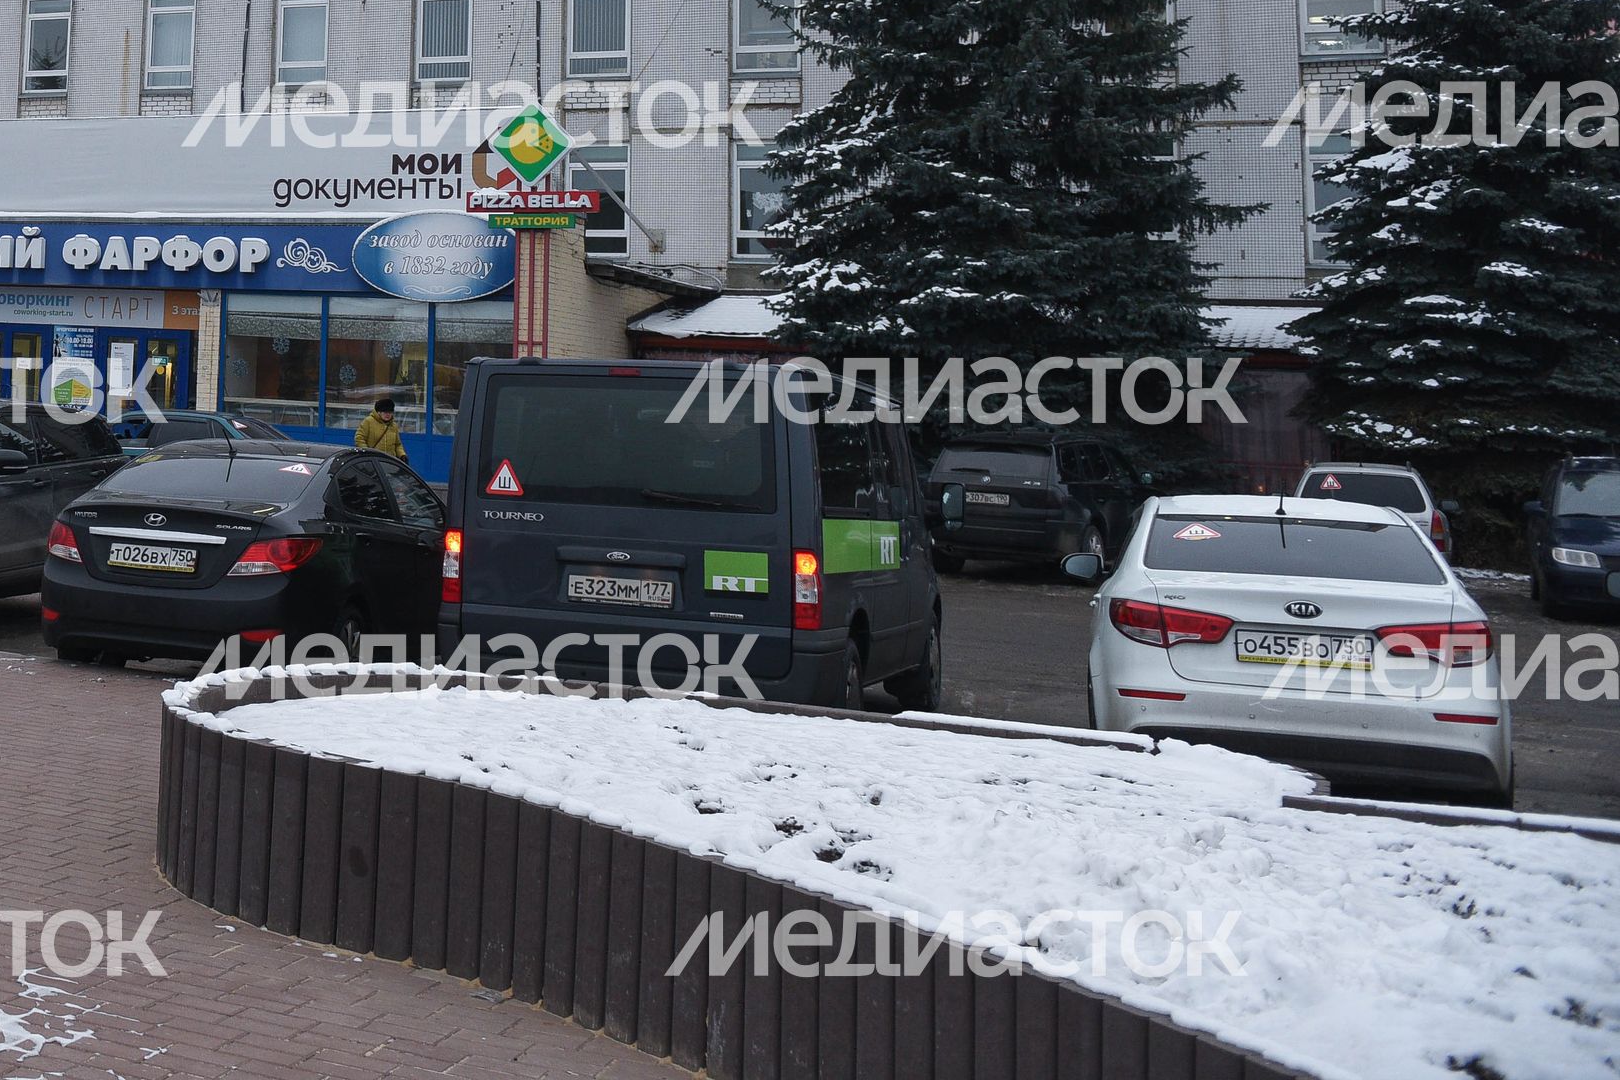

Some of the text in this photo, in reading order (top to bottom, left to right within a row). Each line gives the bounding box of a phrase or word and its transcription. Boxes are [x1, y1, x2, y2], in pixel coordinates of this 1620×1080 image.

[392, 153, 462, 175] мои
[273, 177, 462, 208] документы
[470, 194, 592, 208] PIZZA BELLA
[494, 216, 569, 227] ТРАТТОРИЯ
[369, 230, 508, 248] завод основан
[62, 235, 270, 274] ФАРФОР
[383, 256, 493, 279] в 1832 году
[13, 308, 74, 318] coworking-start.ru
[83, 296, 154, 321] СТАРТ
[172, 305, 200, 316] 3 эта
[499, 476, 511, 489] Ш
[483, 510, 544, 522] TOURNEO
[215, 523, 253, 531] SOLARIS
[114, 546, 193, 565] Т026ВХ 750
[880, 536, 897, 565] RT
[574, 578, 668, 599] Е323ММ 177
[712, 575, 768, 592] RT
[1290, 604, 1317, 615] KIA
[1244, 635, 1365, 658] О455ВО 750
